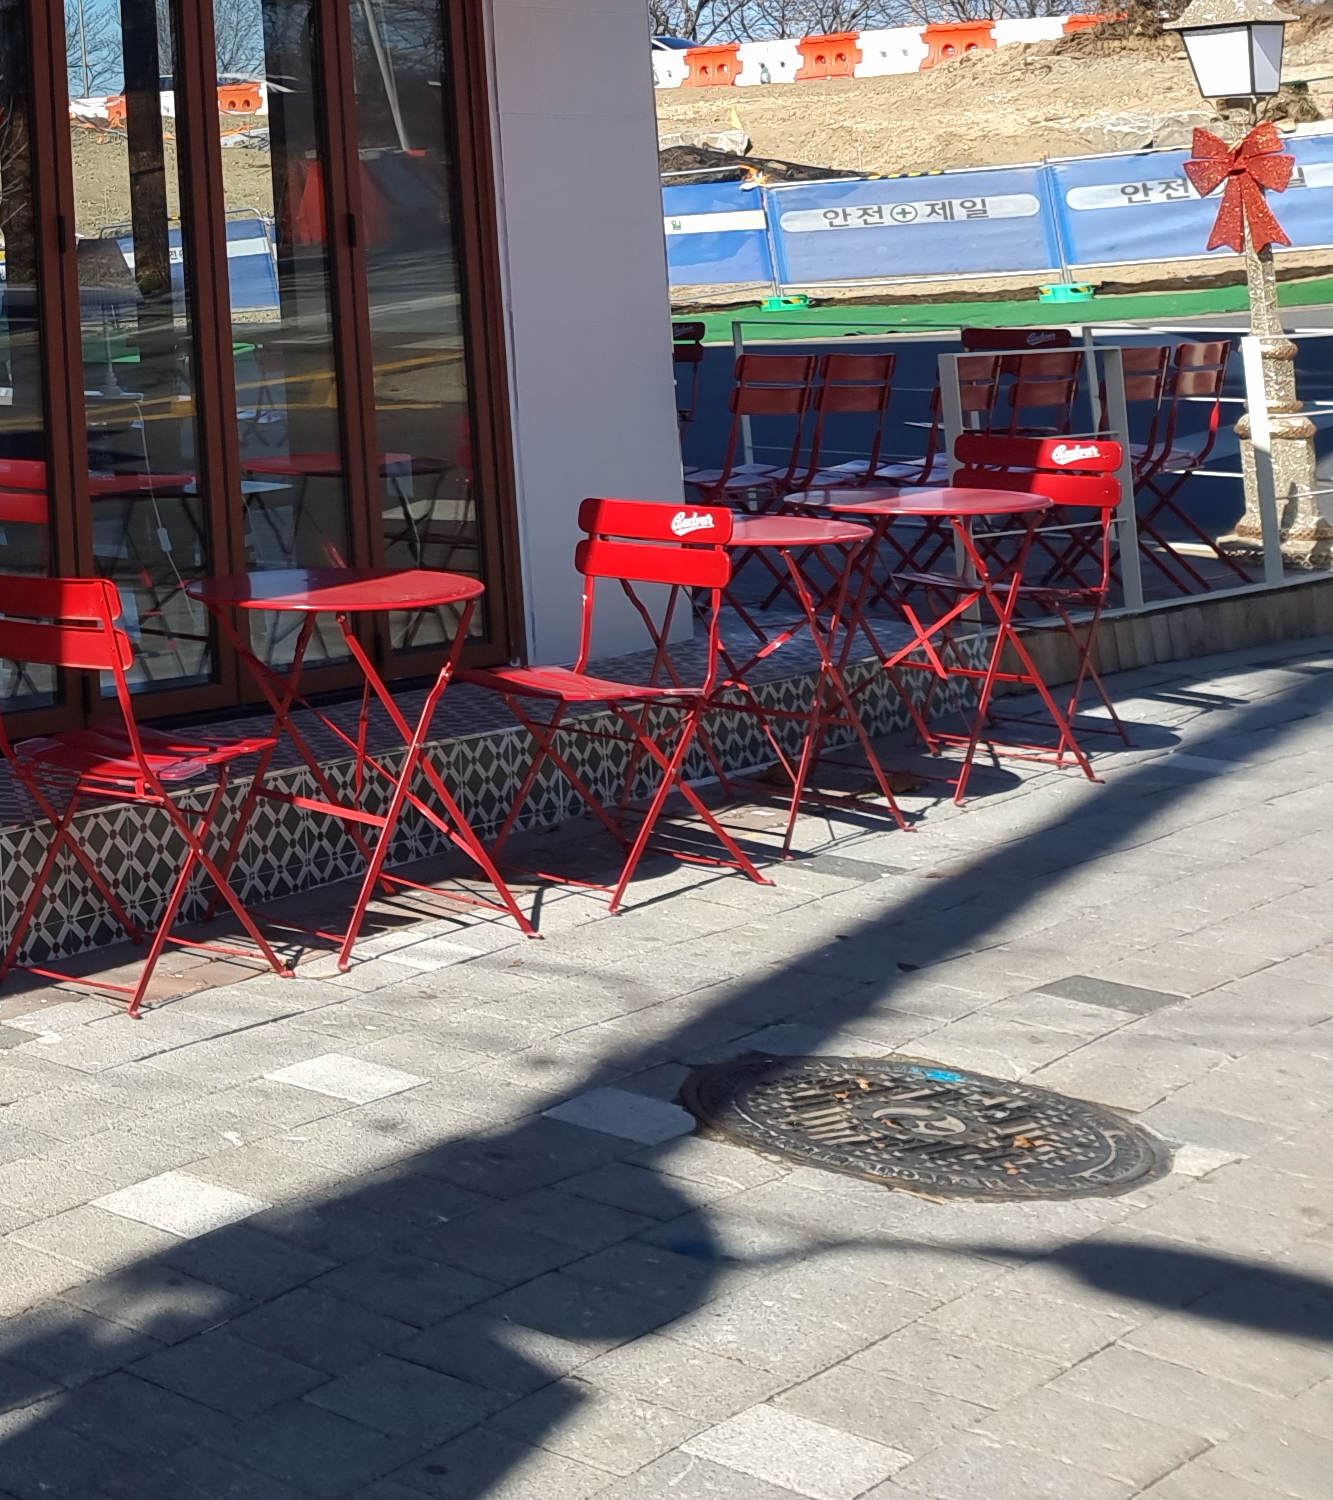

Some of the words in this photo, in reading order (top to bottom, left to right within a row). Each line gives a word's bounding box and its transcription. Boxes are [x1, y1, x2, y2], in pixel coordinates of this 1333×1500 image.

[1120, 178, 1190, 204] 안전
[822, 206, 885, 228] 안전
[924, 198, 990, 221] 제일
